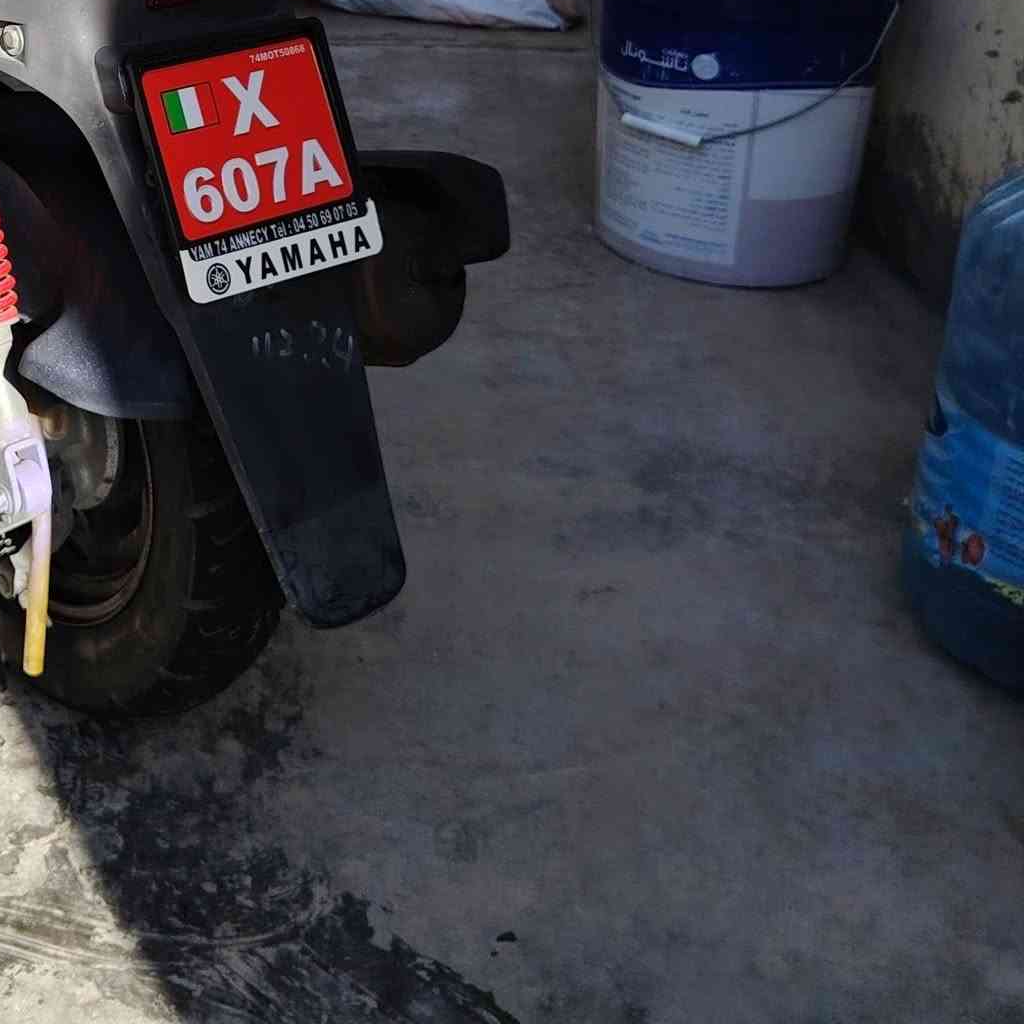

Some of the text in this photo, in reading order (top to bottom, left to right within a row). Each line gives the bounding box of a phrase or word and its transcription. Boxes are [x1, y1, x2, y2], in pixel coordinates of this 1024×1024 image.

[222, 69, 280, 136] X
[190, 241, 214, 261] YAM
[214, 237, 228, 256] 74
[229, 225, 270, 252] ANNECY
[293, 216, 306, 233] 04
[306, 212, 319, 230] 50
[319, 208, 333, 225] 69
[345, 201, 358, 217] 05
[235, 225, 372, 285] YAMAHA
